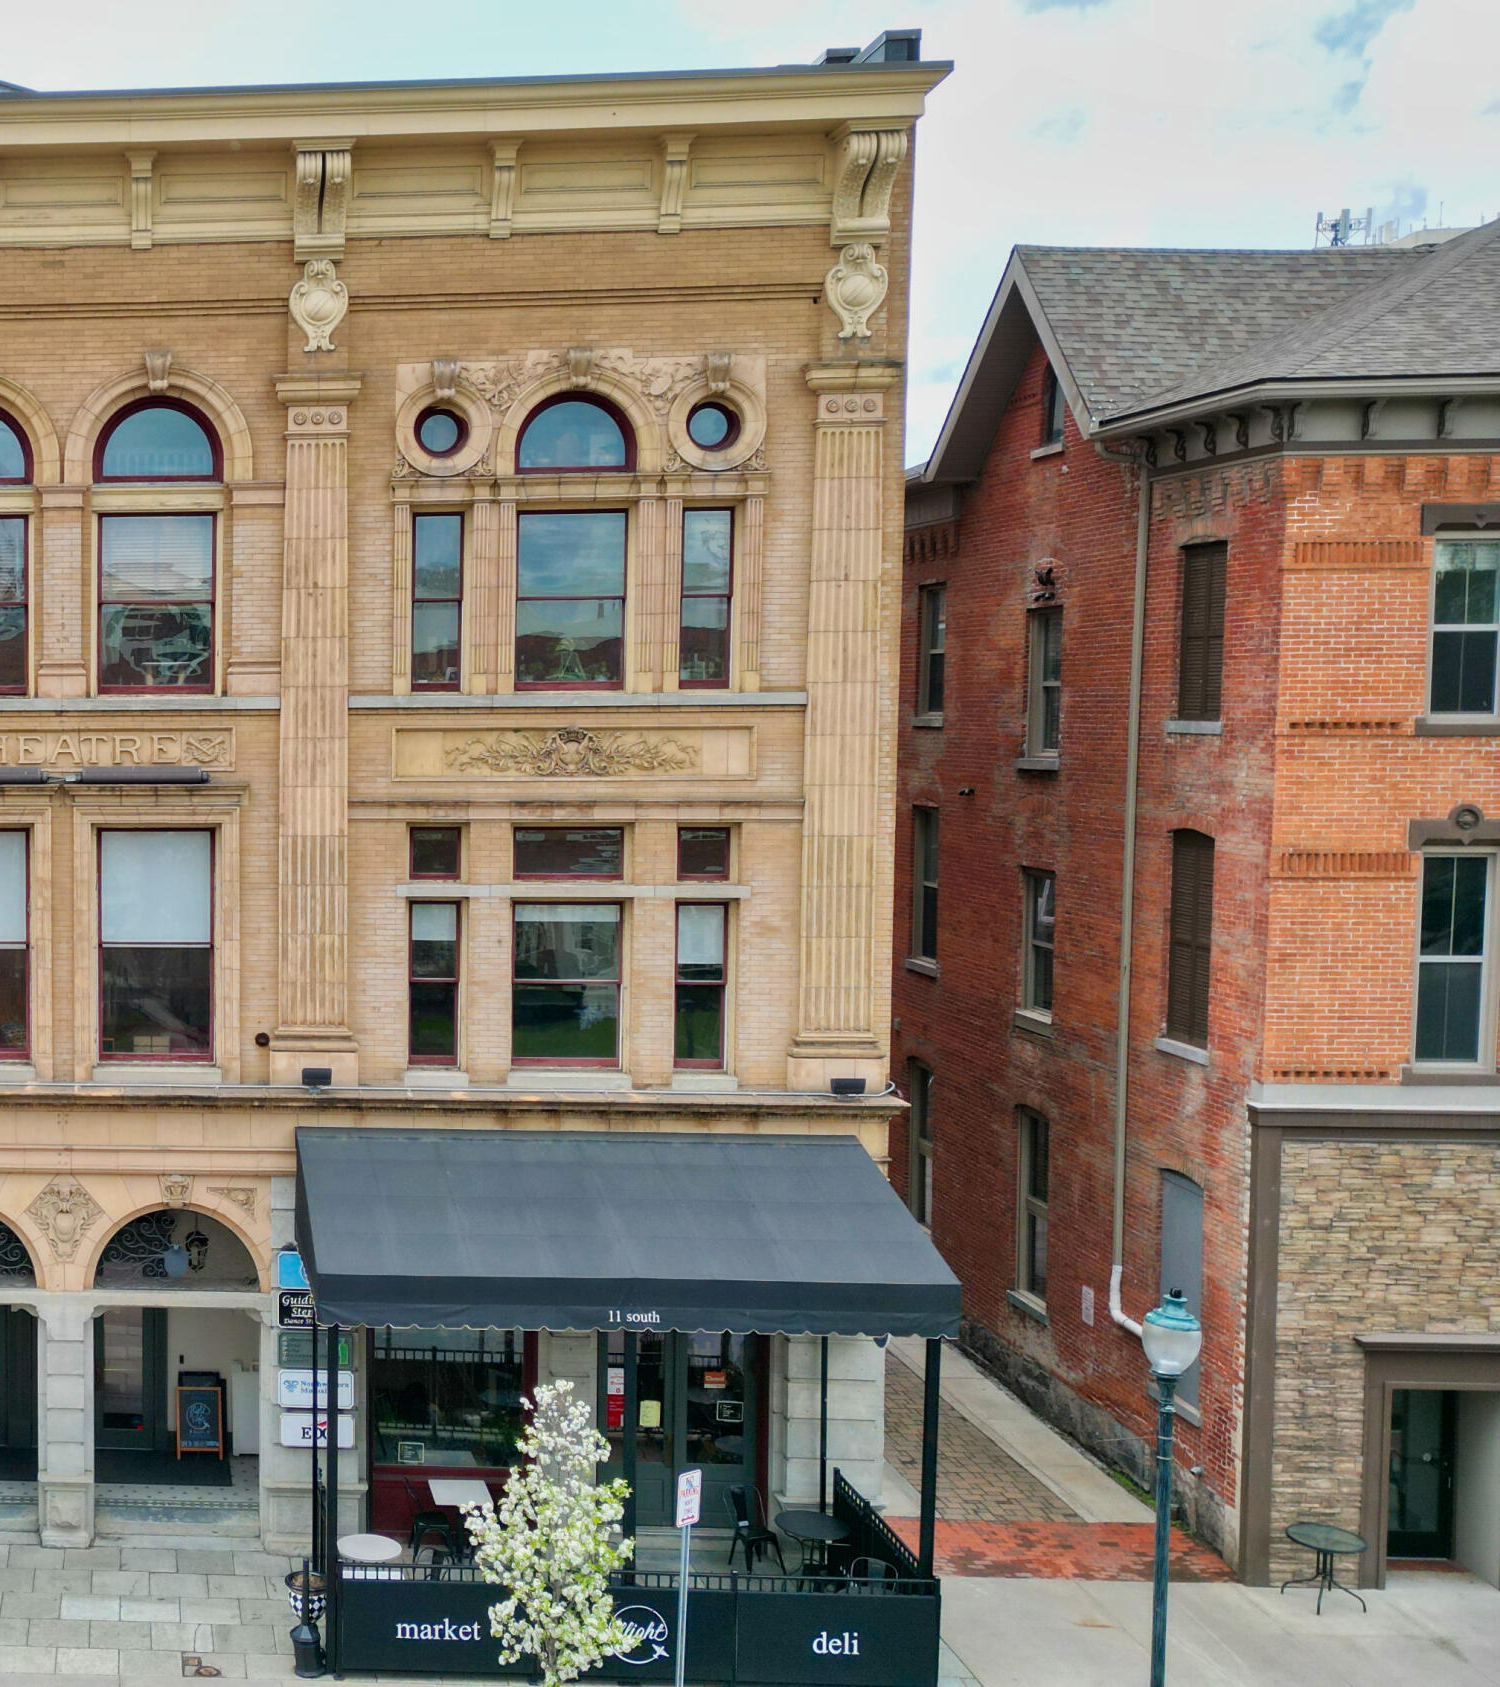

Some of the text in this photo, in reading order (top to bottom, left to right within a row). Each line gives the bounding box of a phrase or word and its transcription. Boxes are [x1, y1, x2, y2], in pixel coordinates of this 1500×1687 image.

[609, 1310, 660, 1323] 11 south
[395, 1618, 481, 1640] market
[812, 1631, 860, 1655] deli
